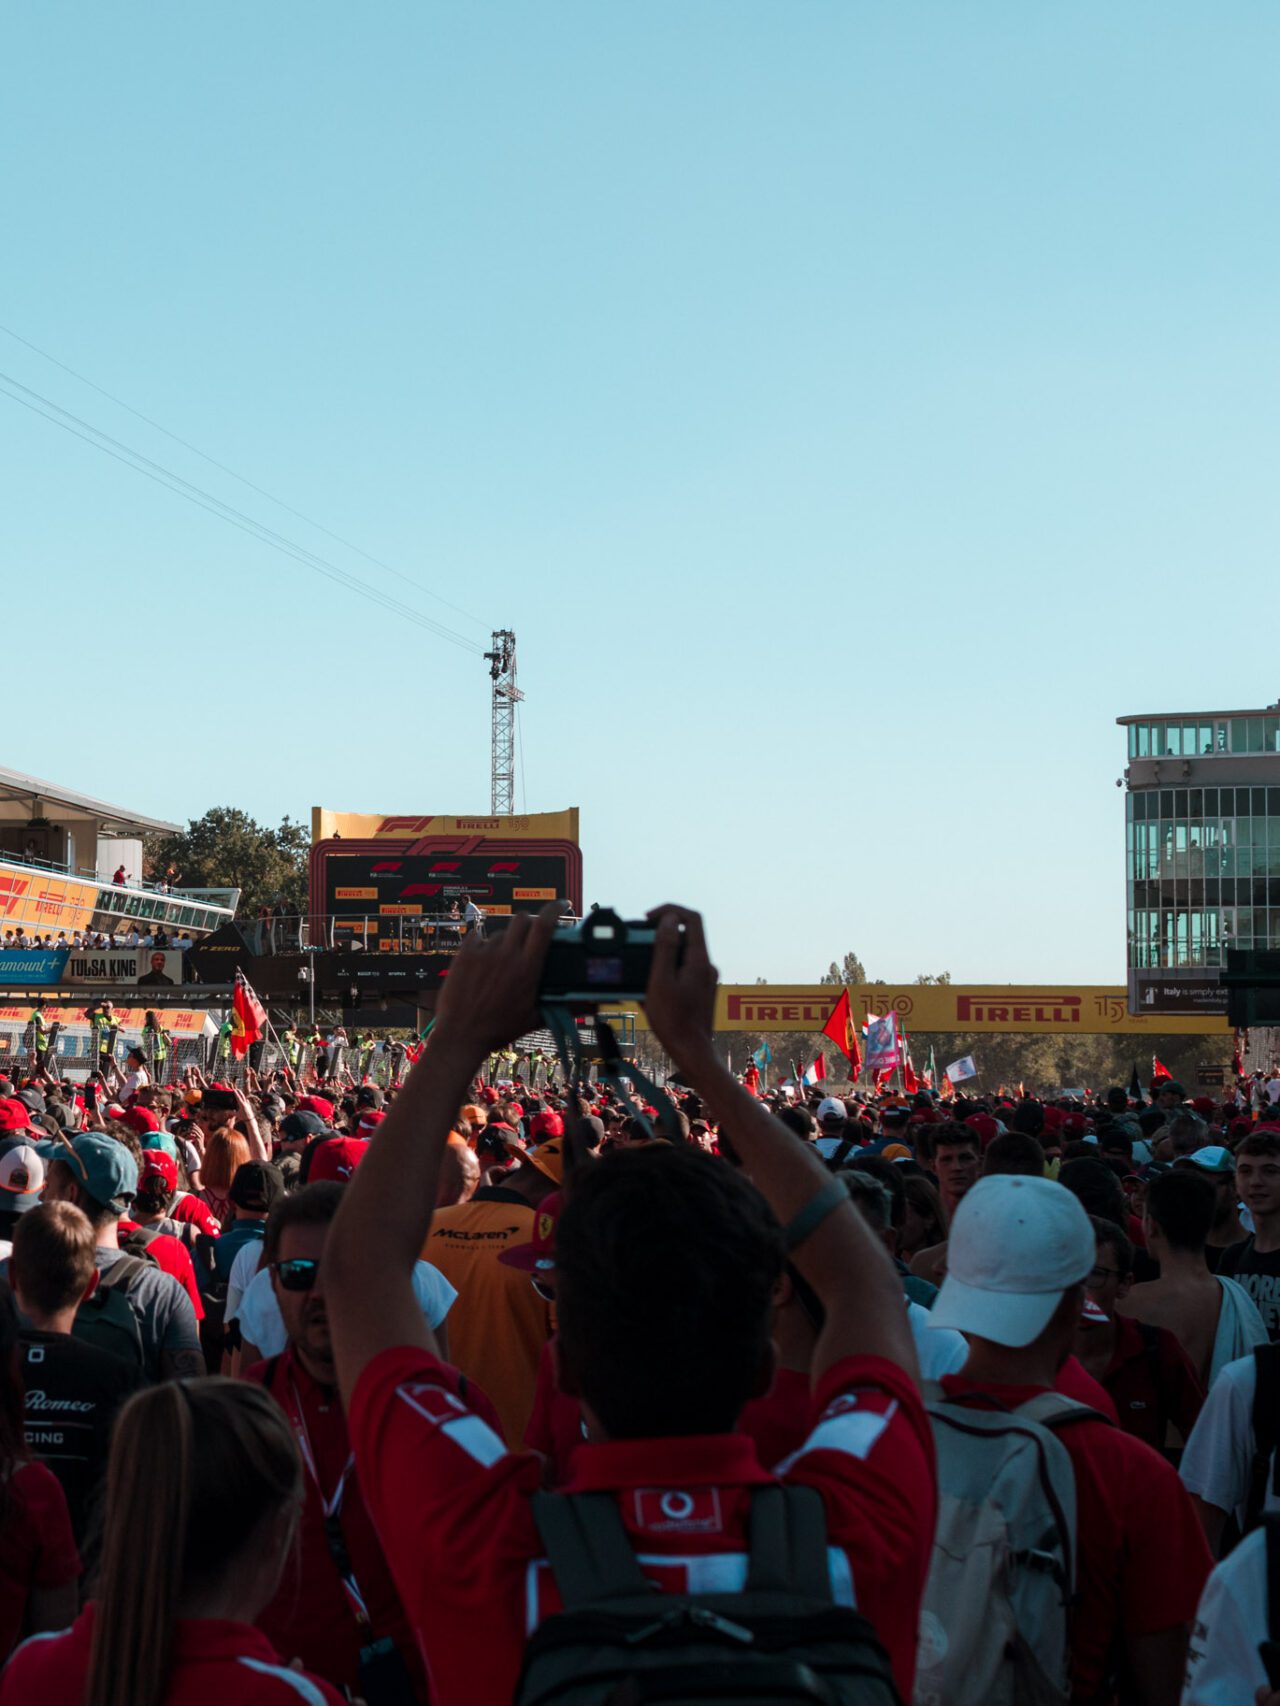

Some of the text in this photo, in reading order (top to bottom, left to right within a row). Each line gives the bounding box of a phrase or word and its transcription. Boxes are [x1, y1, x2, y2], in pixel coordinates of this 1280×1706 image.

[456, 819, 500, 830] PIRELLI
[35, 891, 66, 916] PIRELLI
[70, 958, 137, 978] TULSA KING
[1164, 987, 1181, 997] Italy
[1182, 987, 1188, 996] is
[1189, 987, 1215, 998] simply
[728, 995, 843, 1020] PIRELL
[957, 995, 1083, 1022] PIRELLI
[432, 1228, 509, 1241] McLaren
[25, 1390, 96, 1412] Romeo
[23, 1432, 65, 1444] CING
